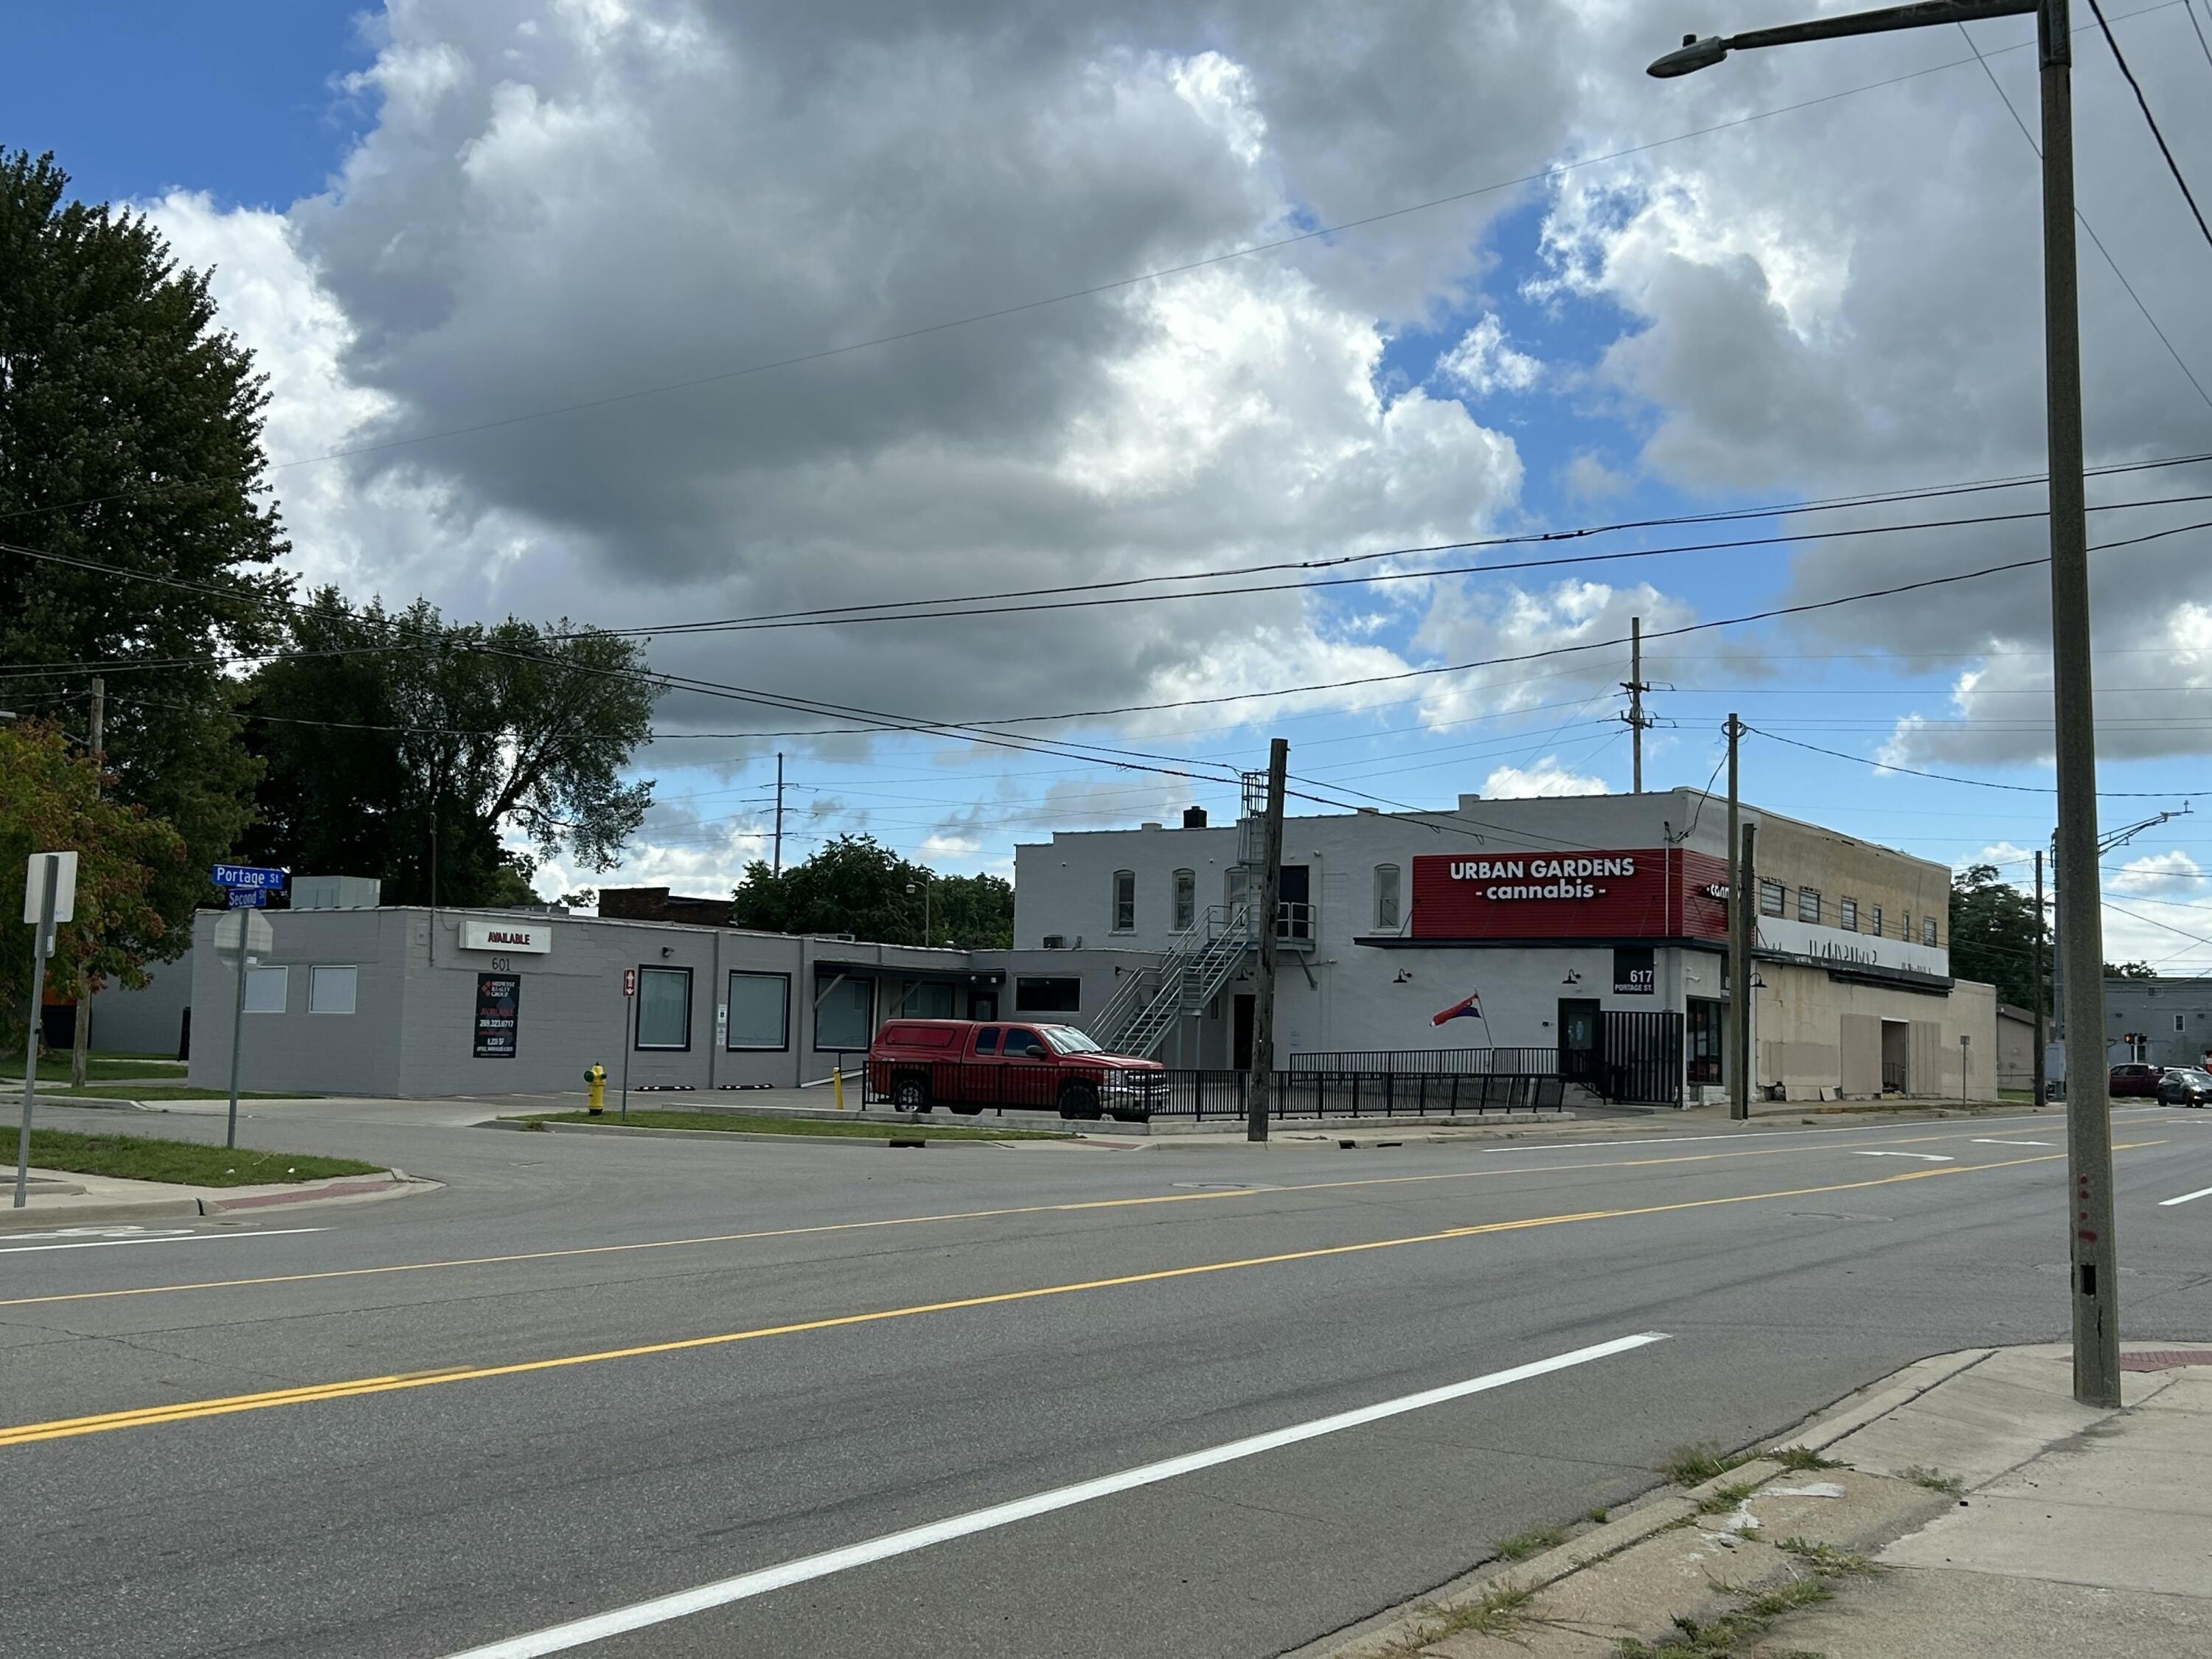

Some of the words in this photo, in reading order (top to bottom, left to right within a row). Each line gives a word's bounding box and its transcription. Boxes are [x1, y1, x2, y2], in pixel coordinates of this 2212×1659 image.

[217, 866, 265, 888] Portage
[269, 873, 279, 884] St
[1450, 861, 1523, 880] URBAN
[1530, 858, 1635, 877] GARDENS
[1486, 879, 1594, 900] cannabis
[229, 890, 257, 906] Second
[487, 931, 530, 945] AVAILABLE
[492, 957, 510, 971] 601
[1630, 970, 1652, 983] 617
